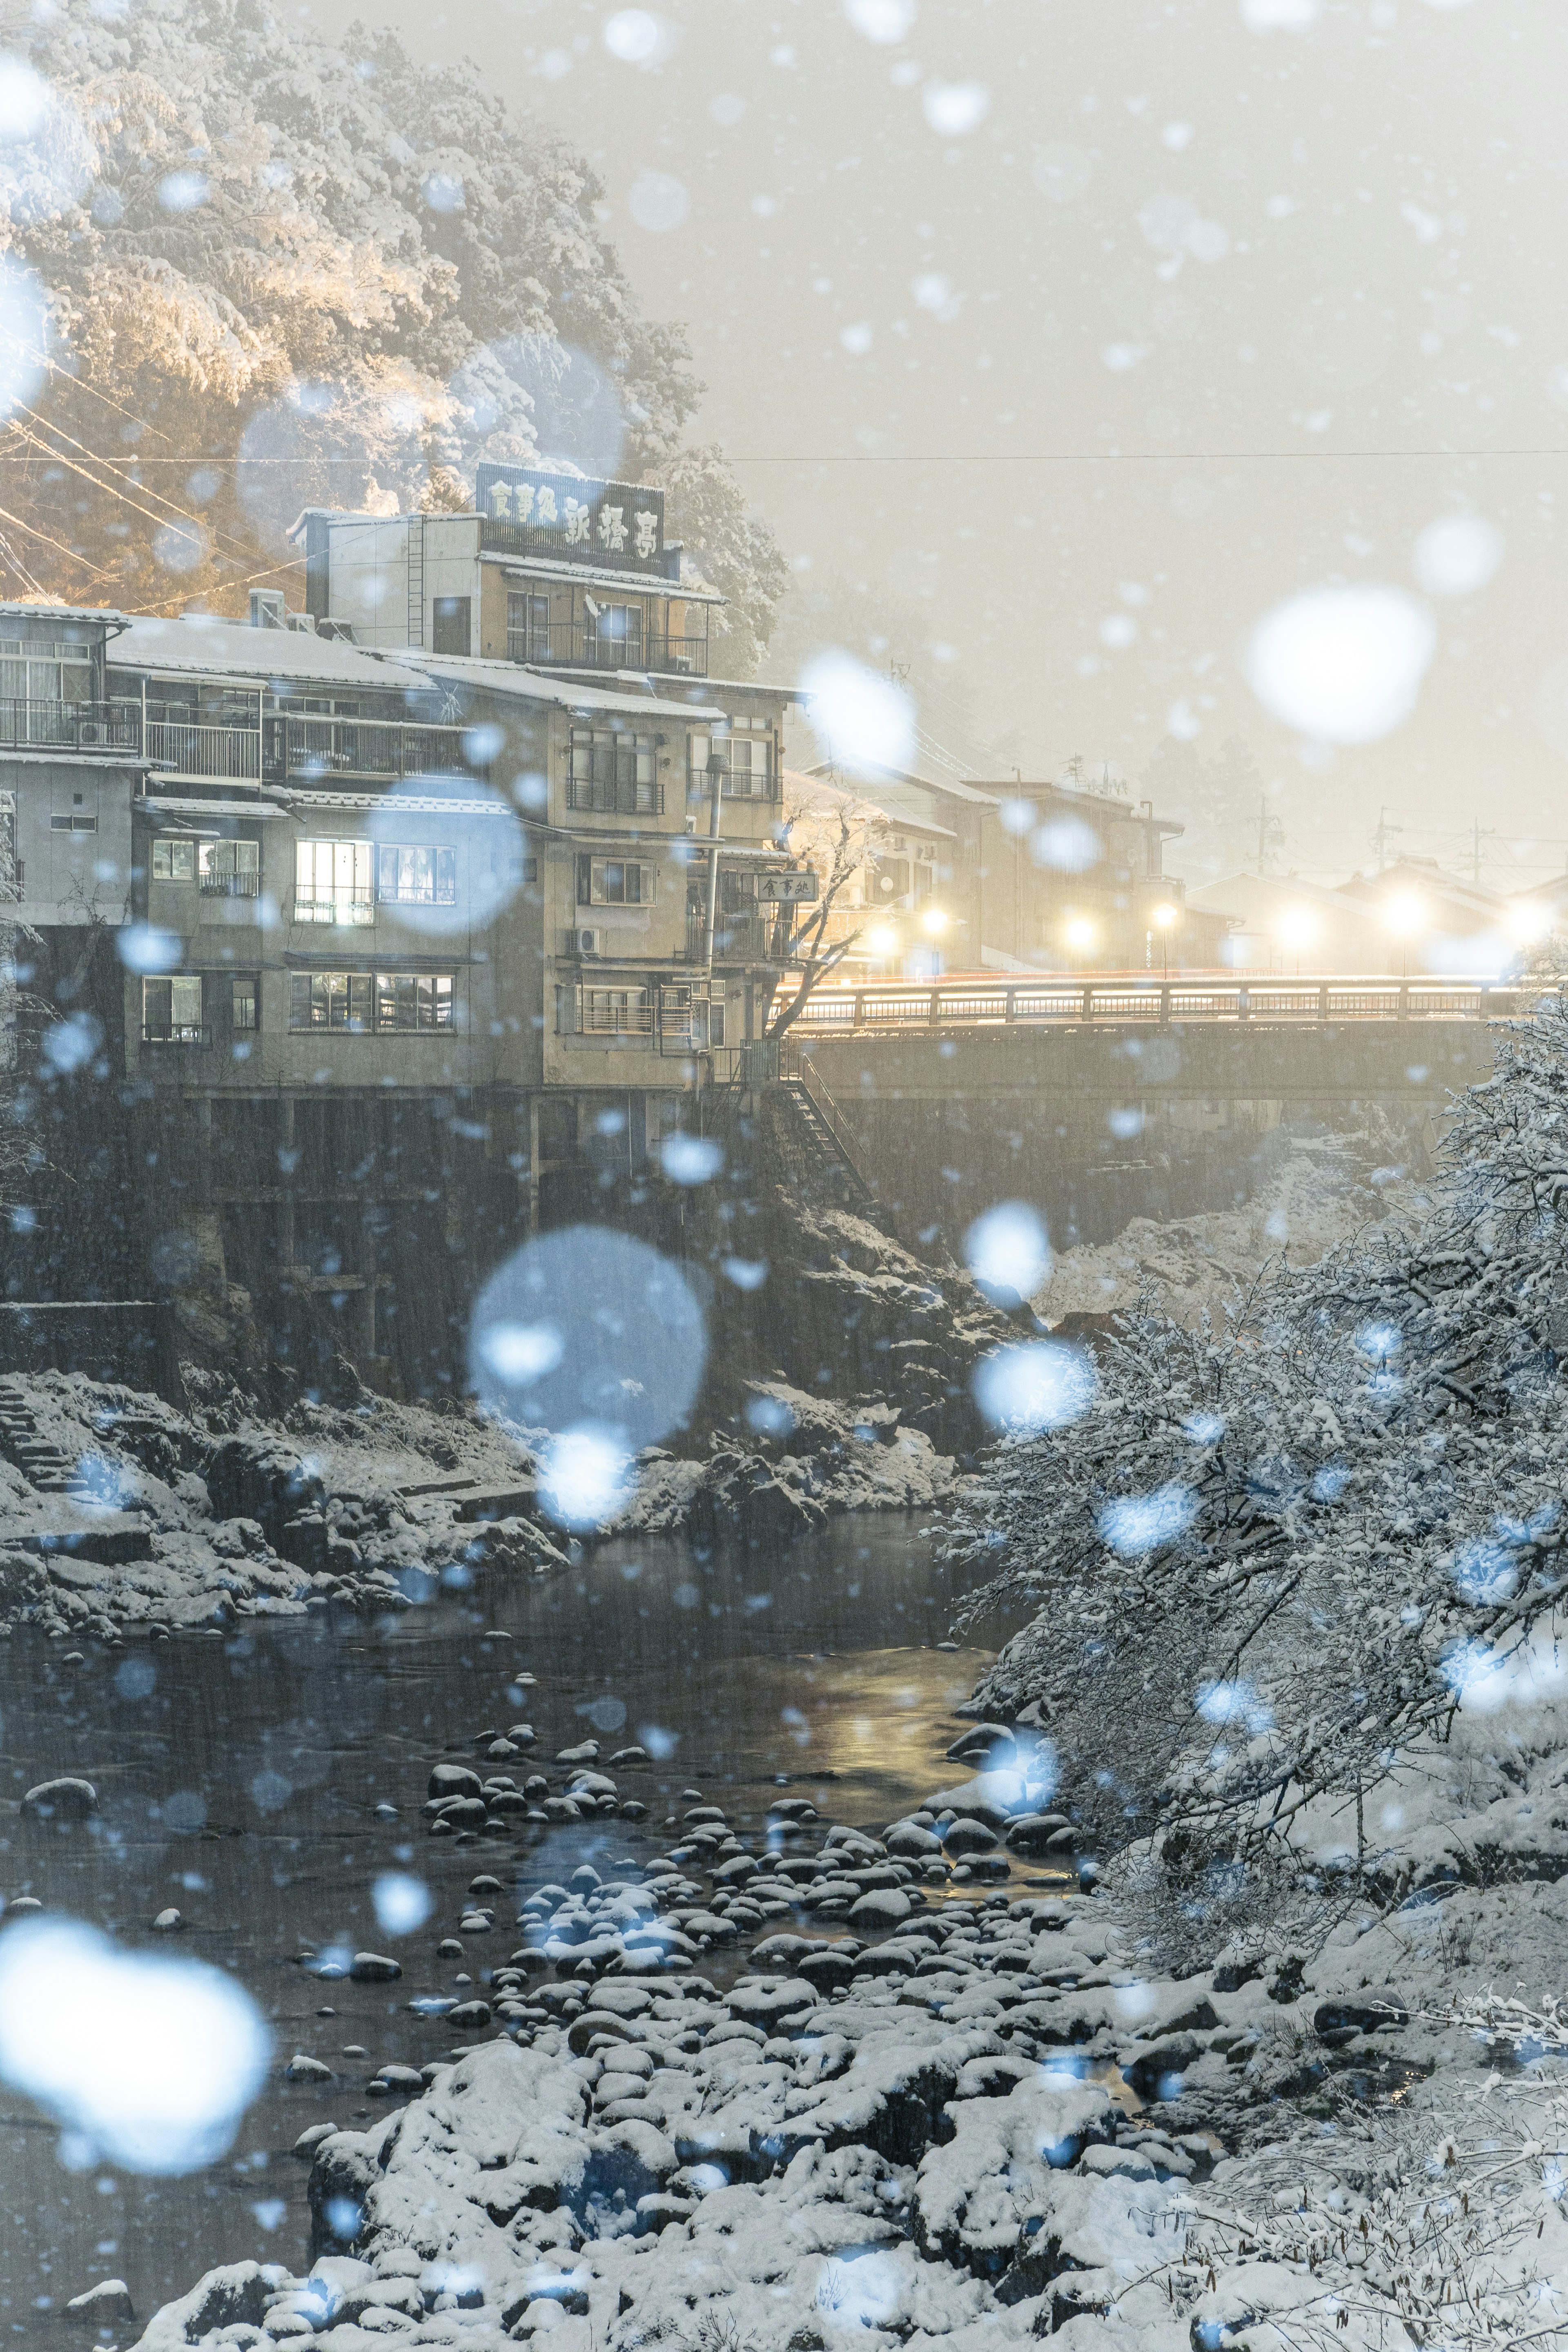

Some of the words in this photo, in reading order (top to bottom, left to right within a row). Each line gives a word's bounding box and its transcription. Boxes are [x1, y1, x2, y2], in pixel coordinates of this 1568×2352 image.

[490, 481, 557, 522] 食事処
[563, 497, 658, 558] 新橋亭
[762, 878, 811, 897] 食事処
